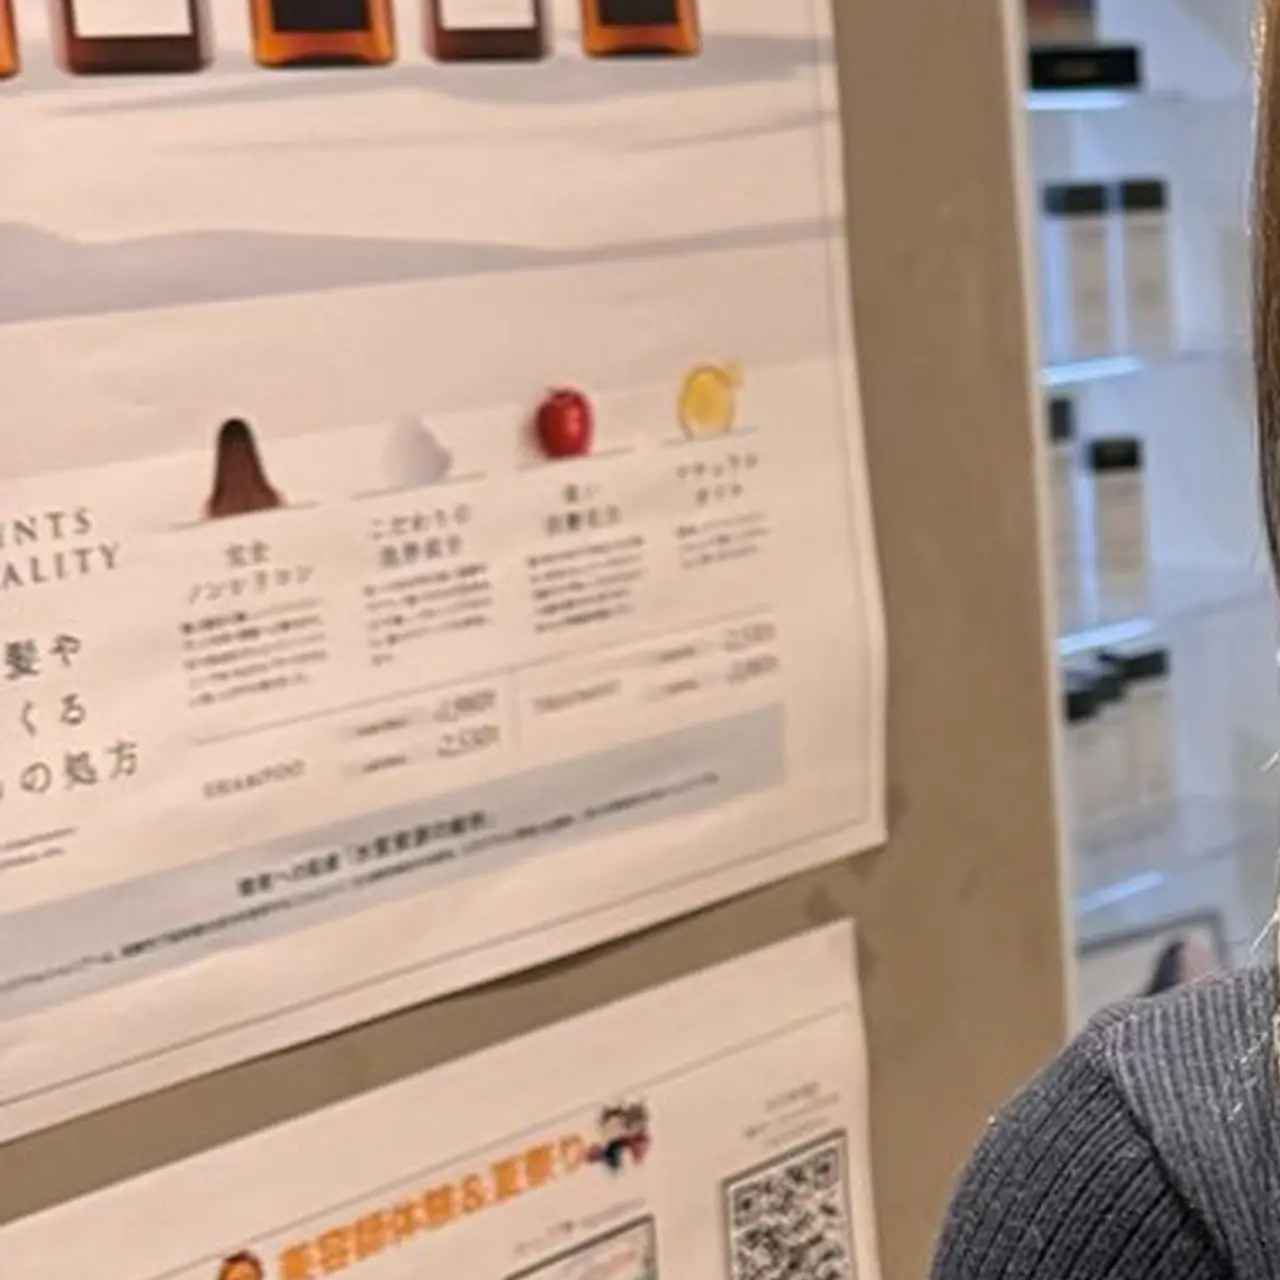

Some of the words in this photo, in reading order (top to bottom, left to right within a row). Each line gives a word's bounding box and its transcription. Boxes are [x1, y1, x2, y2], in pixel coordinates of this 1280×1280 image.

[0, 508, 92, 547] NTS
[0, 741, 138, 797] の処方
